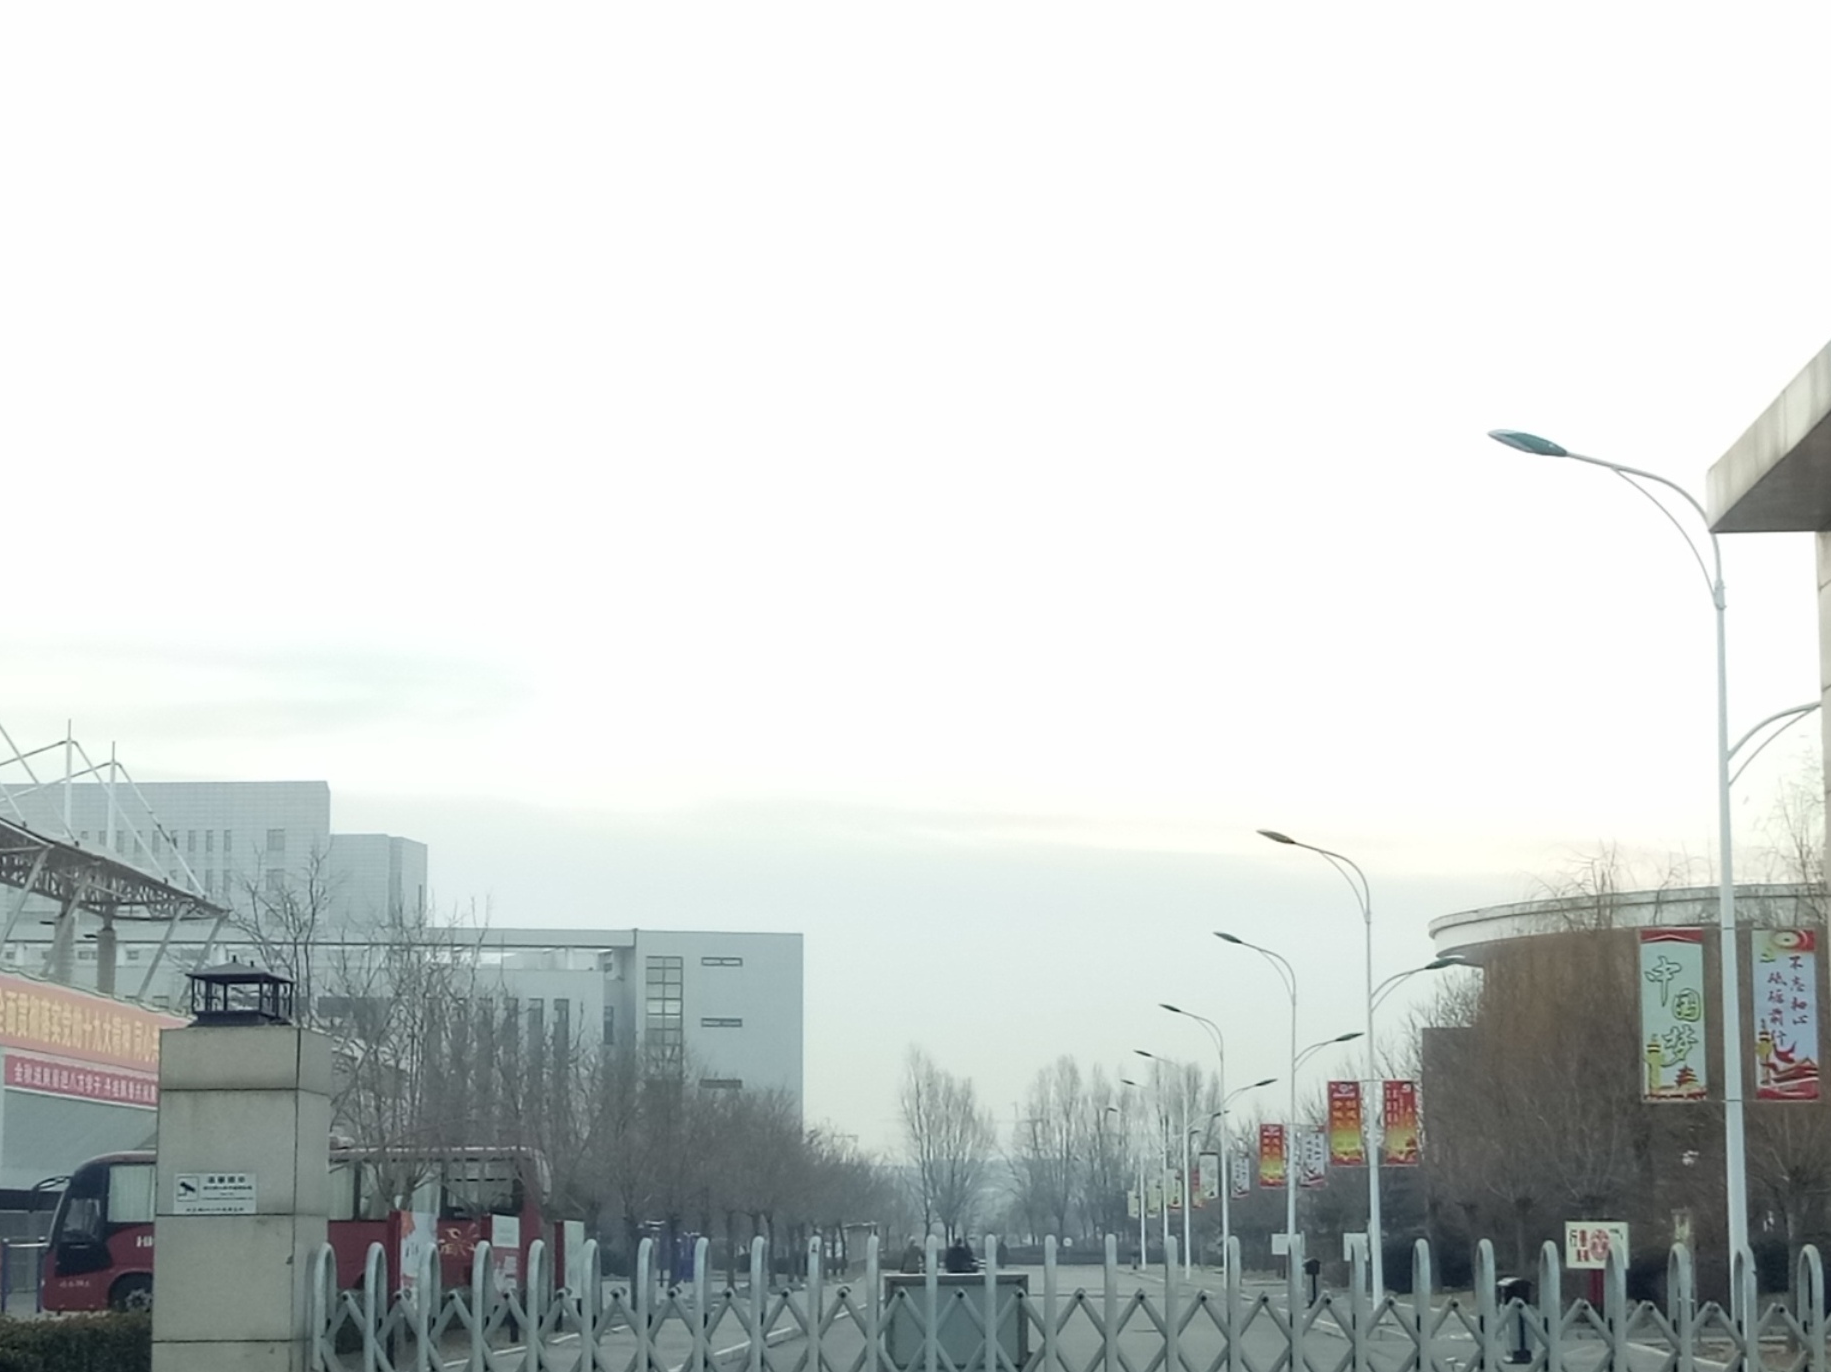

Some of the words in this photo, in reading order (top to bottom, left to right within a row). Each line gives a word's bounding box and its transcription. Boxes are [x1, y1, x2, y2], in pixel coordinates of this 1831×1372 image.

[1644, 955, 1701, 1067] 中国梦
[1767, 971, 1787, 1047] 砥砺前行
[1789, 956, 1809, 1026] 不忘初心
